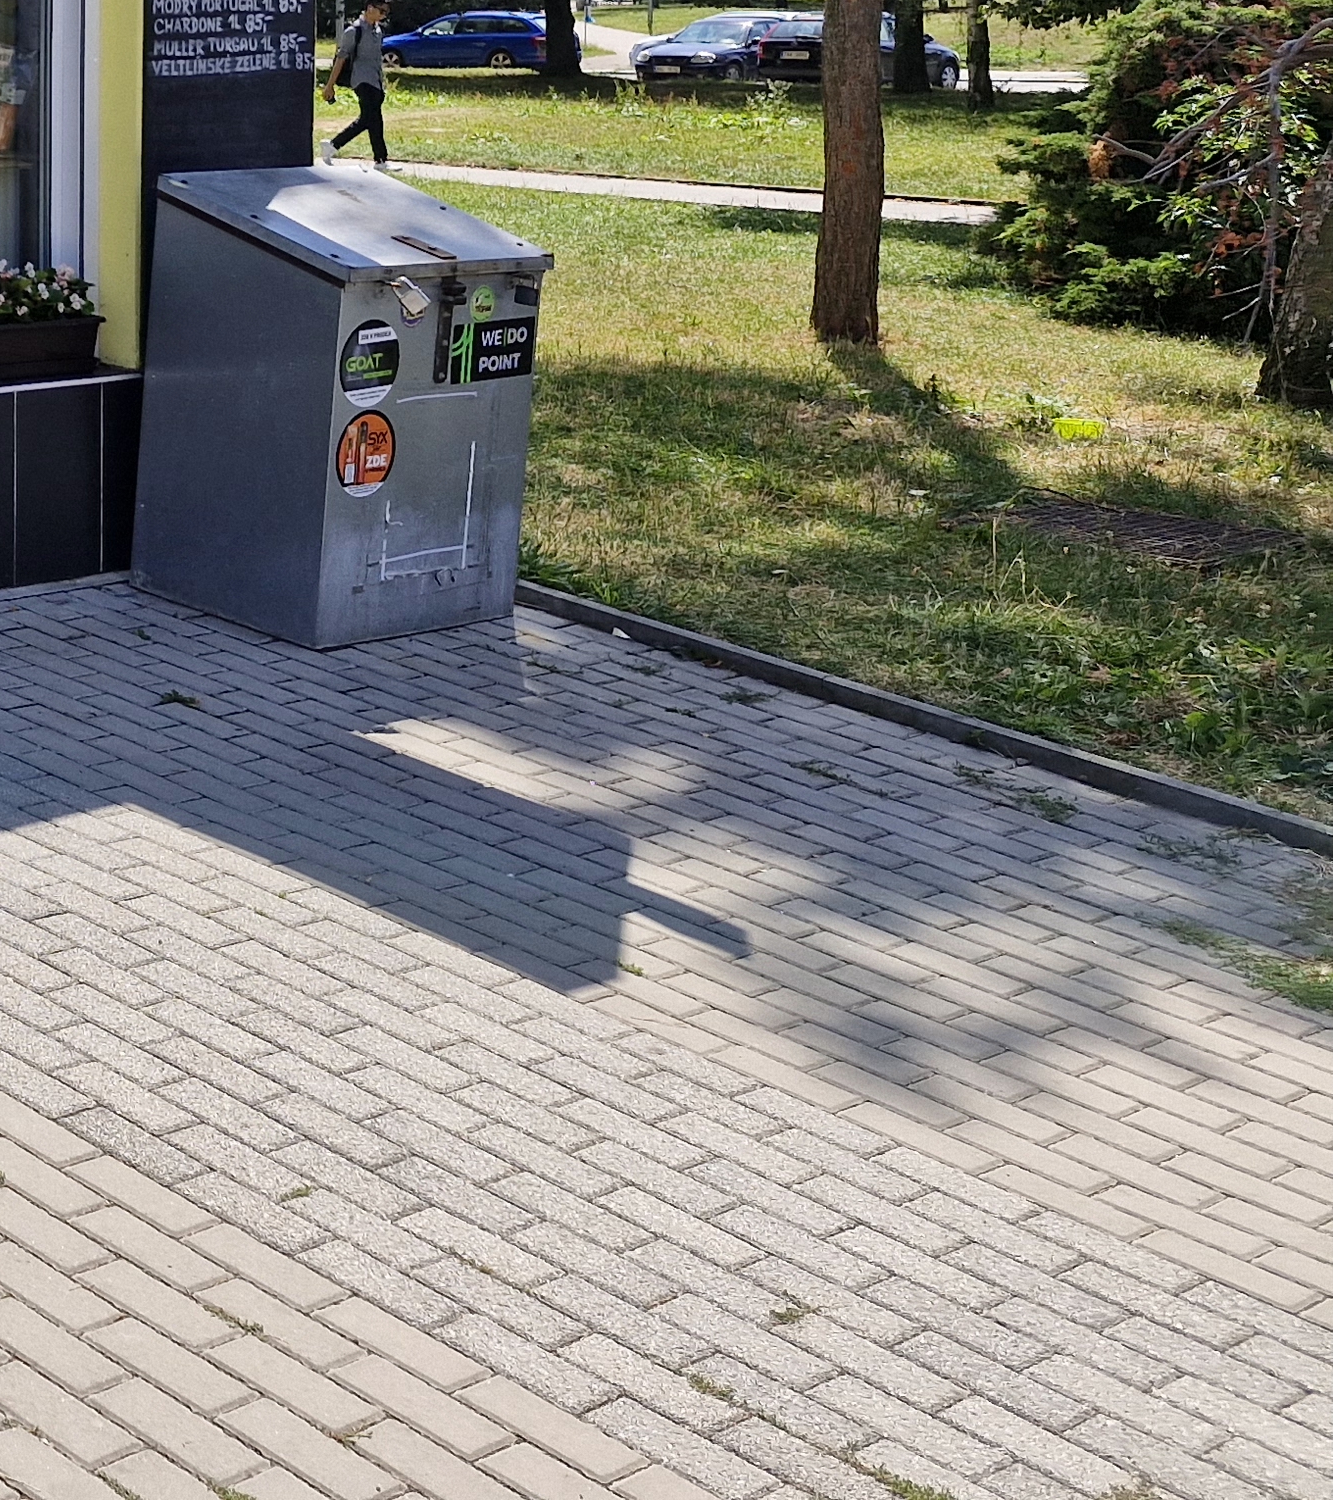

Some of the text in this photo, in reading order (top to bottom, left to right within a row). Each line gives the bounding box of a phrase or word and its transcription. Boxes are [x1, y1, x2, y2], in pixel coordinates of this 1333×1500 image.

[153, 16, 224, 35] CHARDONE
[153, 39, 205, 57] MULLER
[207, 37, 259, 53] TURGAU
[345, 353, 384, 373] GOAT
[479, 352, 521, 373] POINT
[365, 454, 388, 469] ZDE
